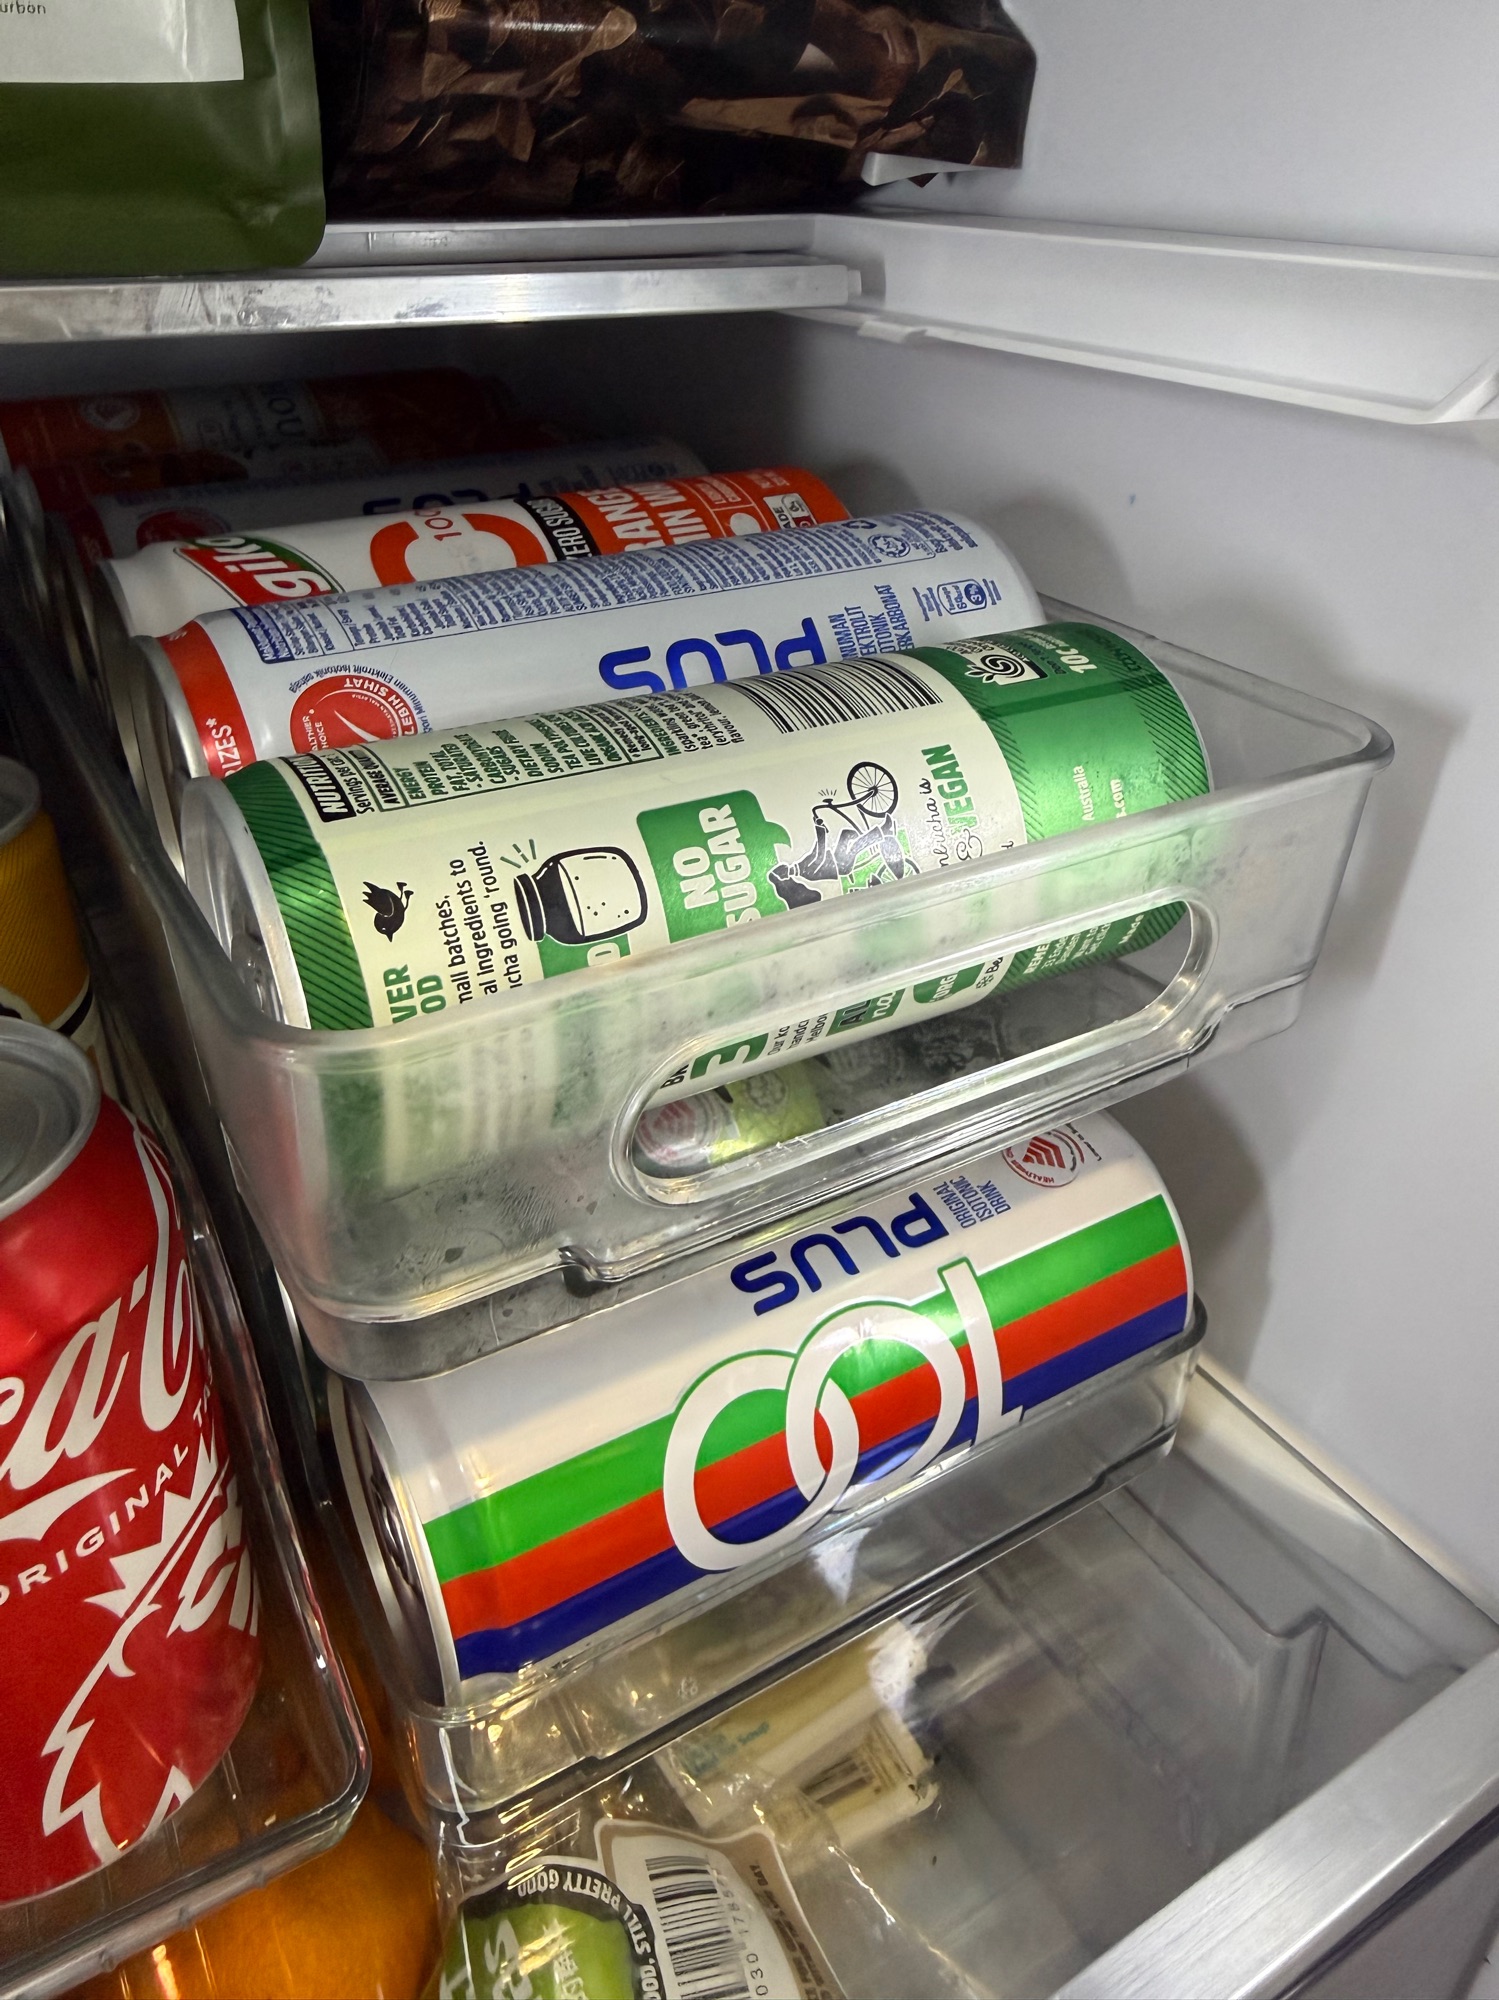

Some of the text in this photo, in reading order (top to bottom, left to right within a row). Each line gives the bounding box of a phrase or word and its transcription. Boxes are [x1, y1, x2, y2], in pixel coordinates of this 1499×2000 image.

[0, 2, 47, 15] urbon
[580, 489, 666, 551] RANG
[772, 506, 793, 530] ADE
[552, 524, 594, 560] ERO
[828, 613, 859, 660] NUMAN
[844, 606, 877, 655] EKTROLIT
[868, 612, 897, 653] OTONIK
[874, 584, 915, 649] ERKARBONAT
[599, 617, 827, 693] PLUS
[343, 677, 390, 698] SIHAT
[205, 716, 241, 777] RIZES
[302, 715, 318, 751] ALTHIER
[314, 721, 330, 750] HOICE
[413, 760, 449, 797] PROTEIN
[529, 742, 564, 774] SODIUM
[345, 777, 375, 815] Servings
[393, 767, 427, 801] ENERGY
[920, 743, 978, 836] VEGAN
[1072, 765, 1096, 821] Australia
[449, 858, 467, 877] to
[672, 846, 719, 909] NO
[698, 804, 762, 928] SUGAR
[456, 879, 498, 977] ingredients
[490, 901, 517, 949] going
[1022, 943, 1050, 975] REME
[382, 964, 418, 1023] VER
[416, 974, 447, 1014] OD
[450, 969, 474, 1004] mall
[932, 1181, 977, 1229] ORIGINAL
[949, 1175, 995, 1222] ISOTONIC
[977, 1179, 1011, 1215] DRINK
[730, 1191, 950, 1317] PLUS
[663, 1257, 1023, 1571] 100
[562, 1870, 621, 1913] PRETTY
[622, 1904, 652, 1956] STILL
